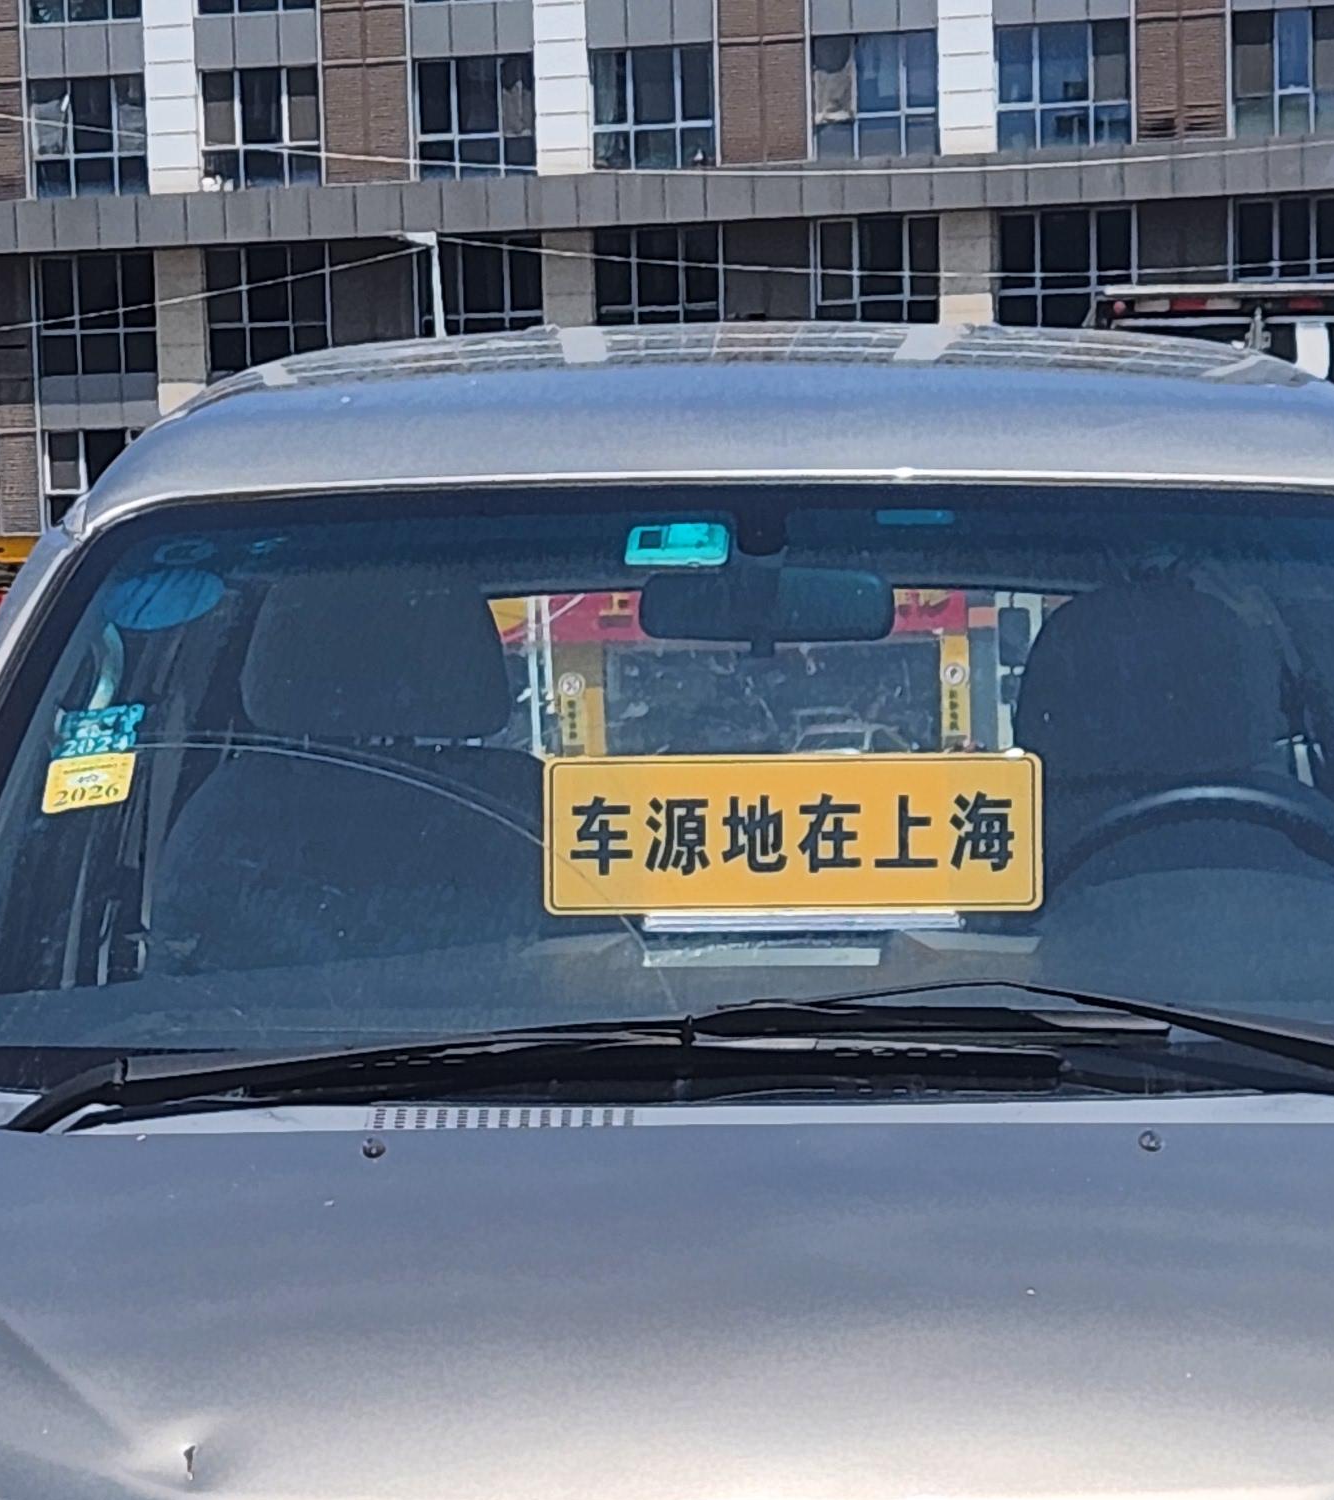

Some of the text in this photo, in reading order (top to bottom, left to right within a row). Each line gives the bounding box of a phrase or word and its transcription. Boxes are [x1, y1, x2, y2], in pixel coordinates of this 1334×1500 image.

[54, 783, 119, 806] 2026
[570, 792, 1015, 876] 车源地在上海
